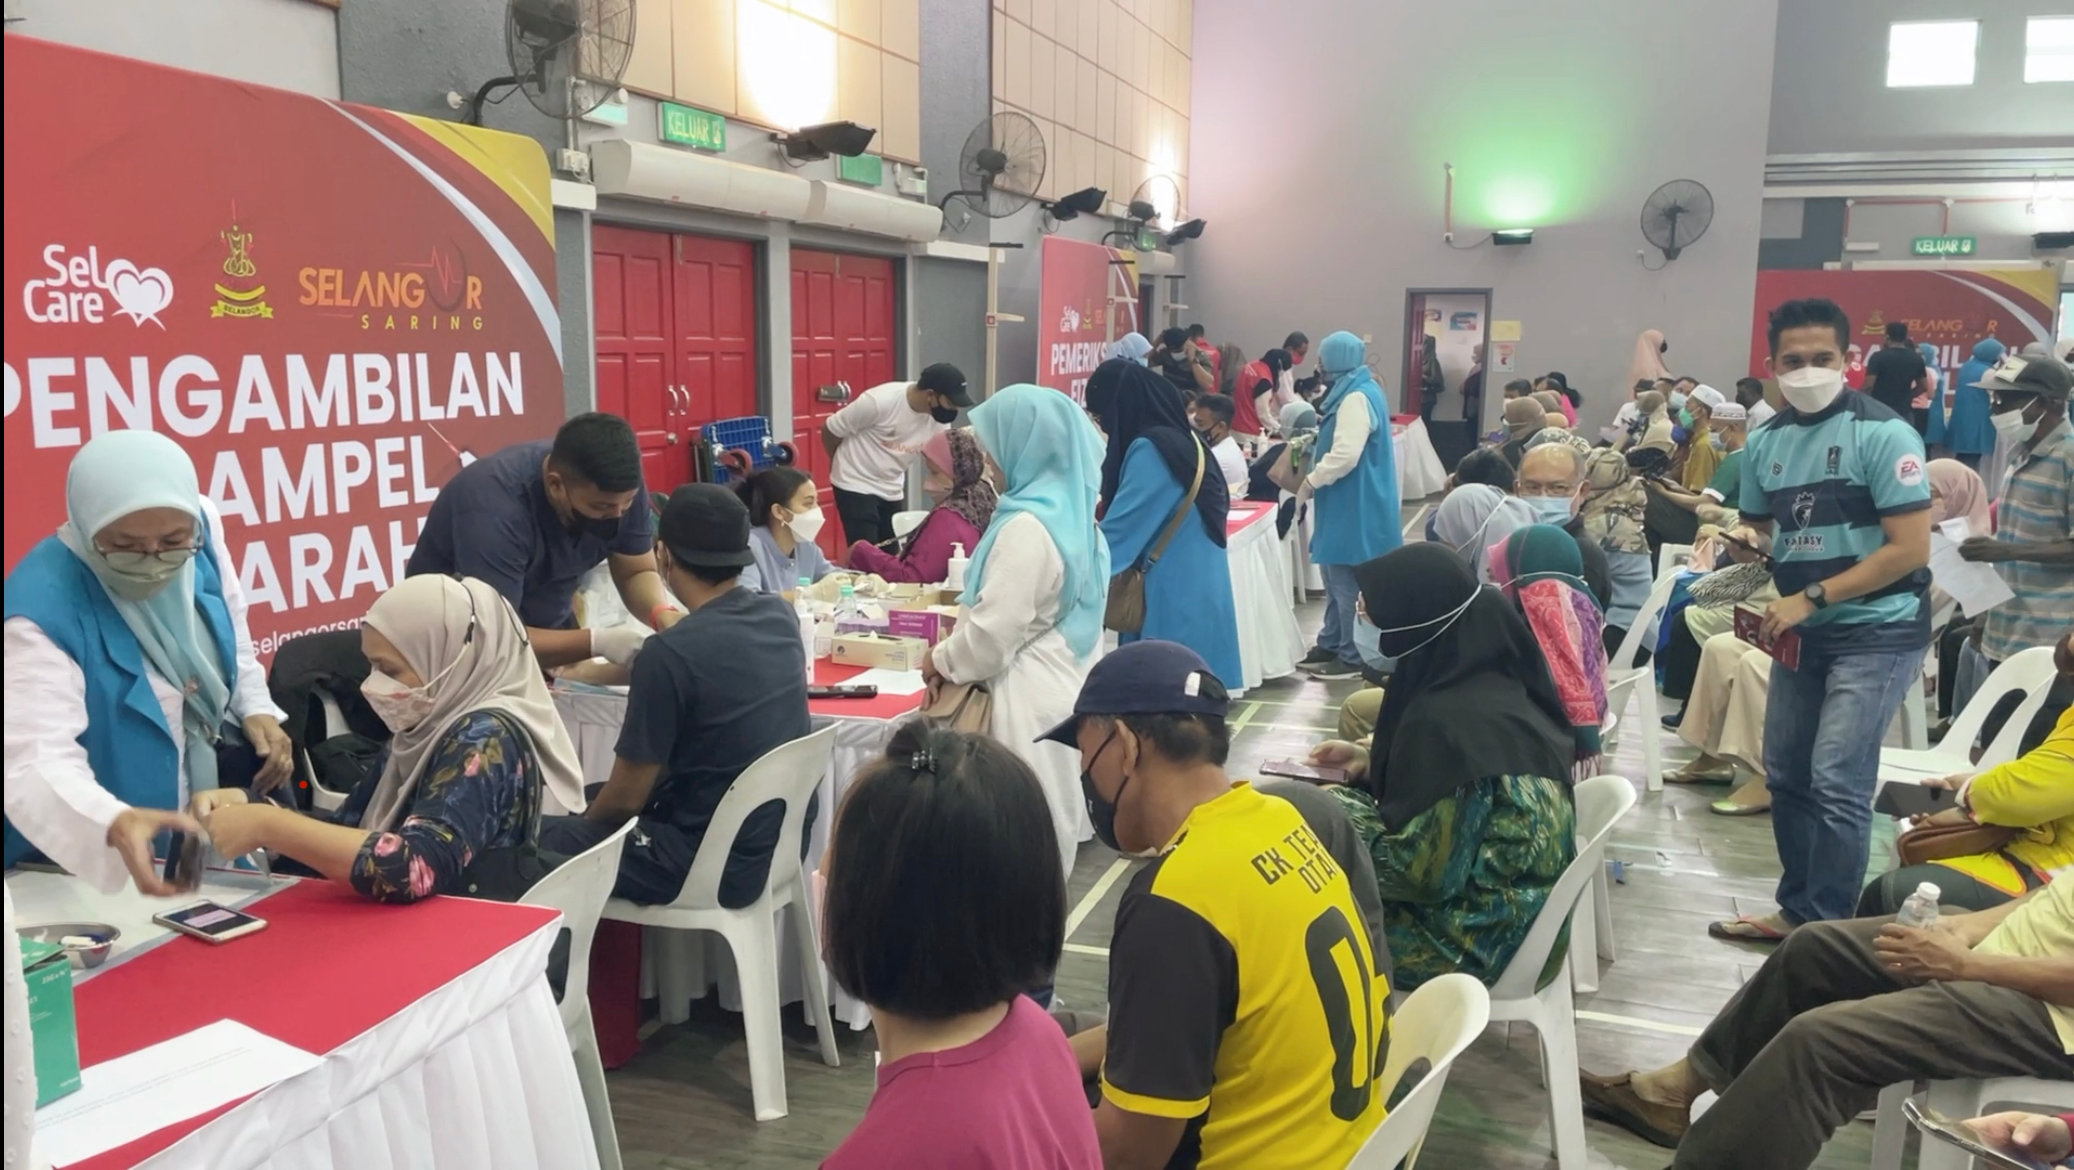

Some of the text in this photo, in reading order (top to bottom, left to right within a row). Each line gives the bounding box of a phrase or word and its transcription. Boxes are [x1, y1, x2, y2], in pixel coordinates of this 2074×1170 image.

[667, 111, 709, 143] KELUAR
[1915, 239, 1958, 254] KELUAR
[43, 244, 109, 288] Sel
[23, 279, 104, 324] Care
[361, 314, 483, 330] SARING
[1051, 342, 1107, 376] PEMERIKS
[1070, 378, 1089, 409] FIZ
[207, 435, 440, 527] AMPEL
[1901, 460, 1920, 474] EA
[240, 516, 428, 613] ARAH
[1251, 825, 1319, 885] CK TEA
